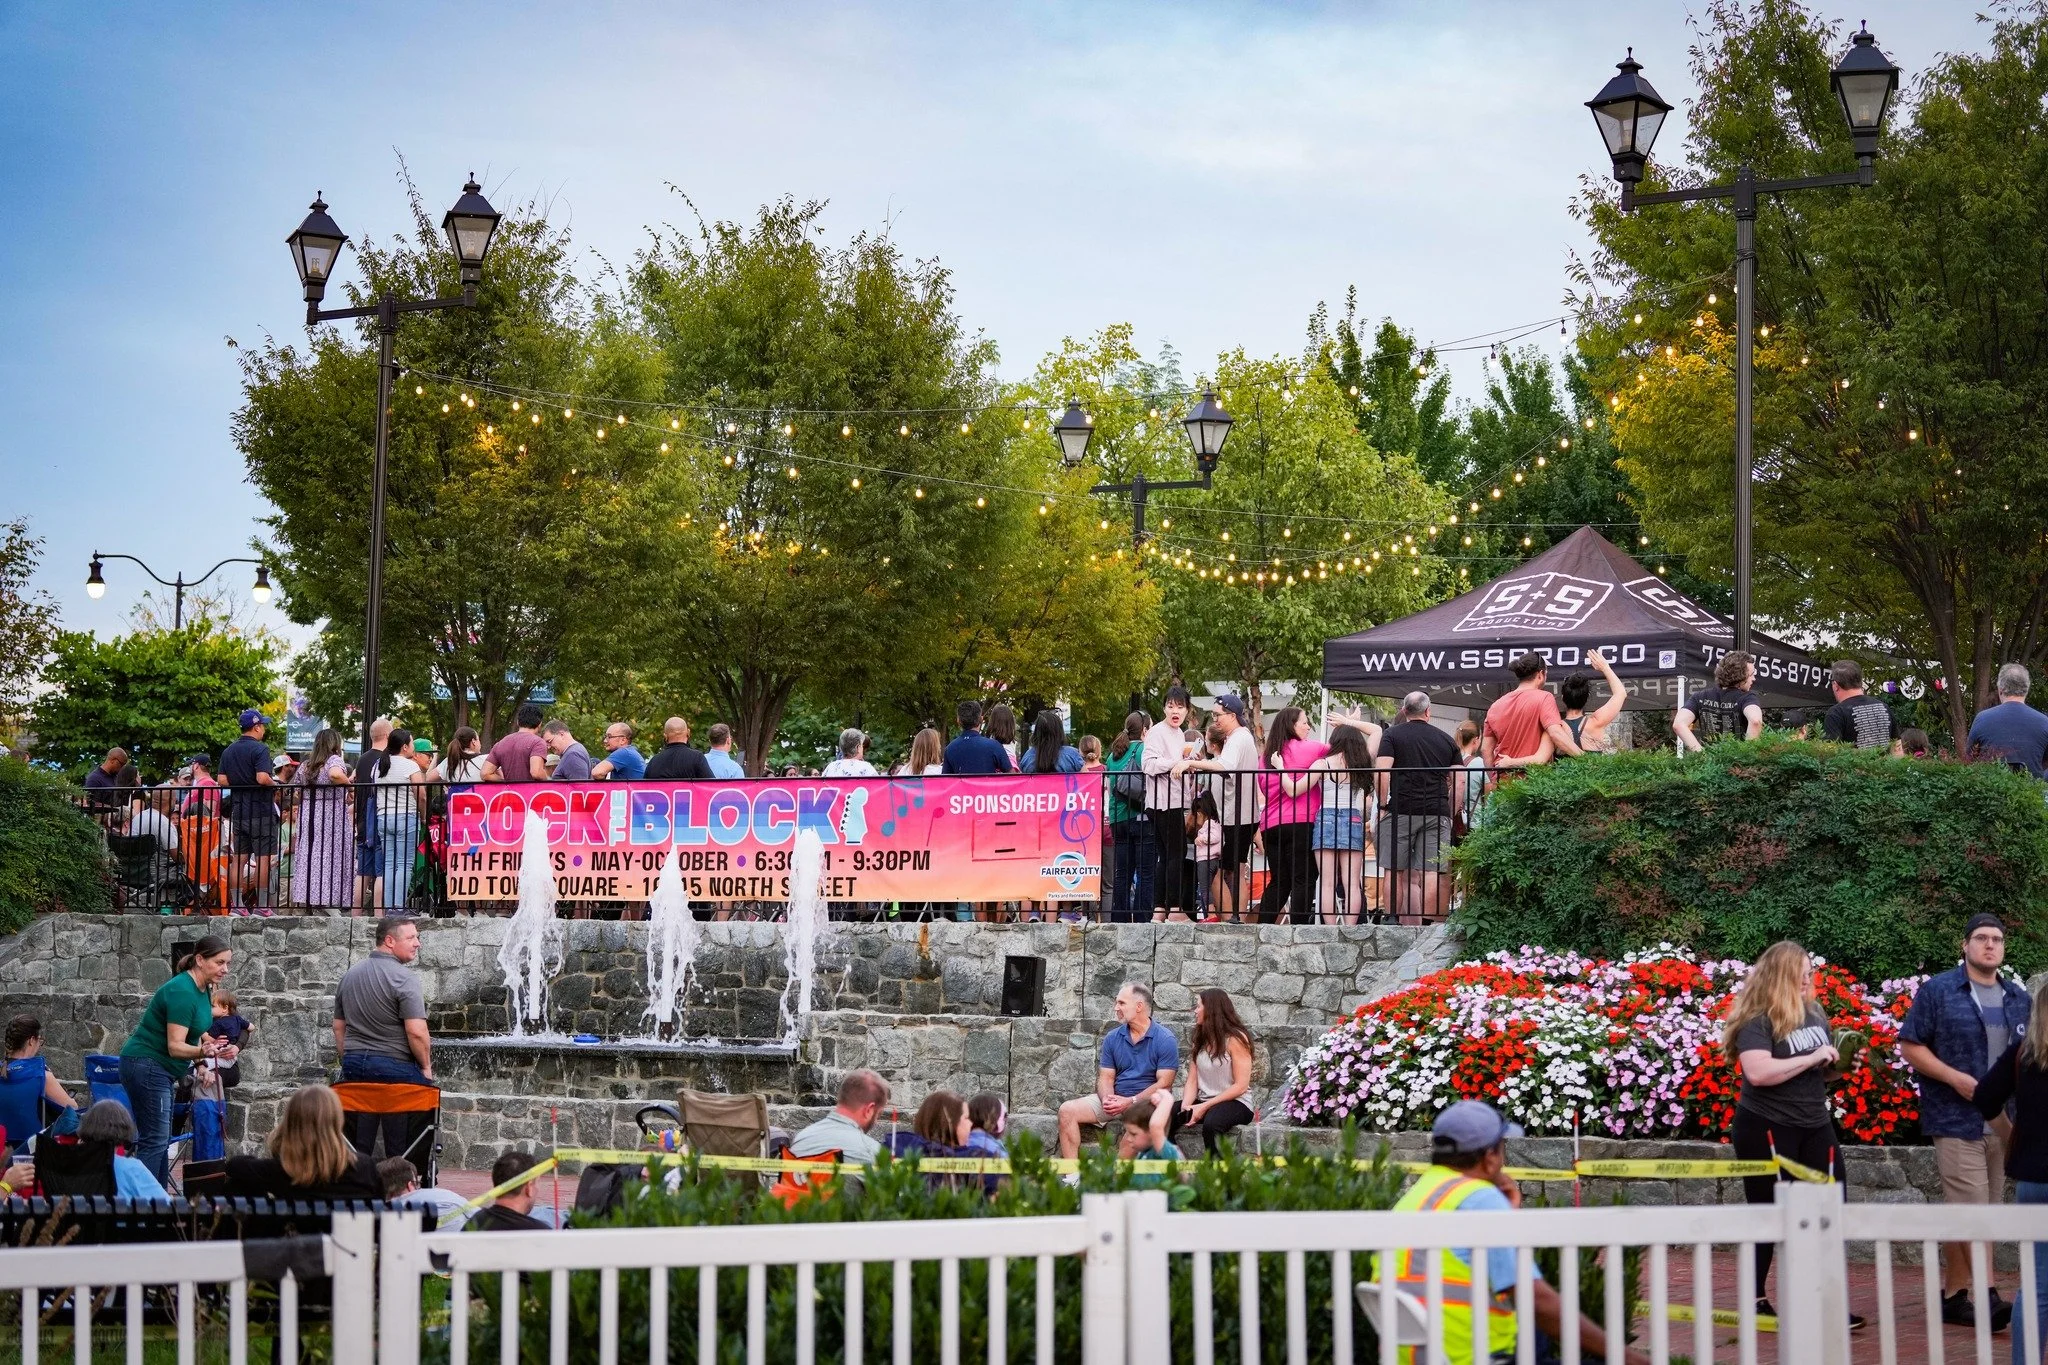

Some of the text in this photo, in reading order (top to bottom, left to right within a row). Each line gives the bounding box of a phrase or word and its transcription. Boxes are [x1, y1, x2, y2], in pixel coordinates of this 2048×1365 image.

[1702, 644, 1833, 689] 7555-8797
[950, 791, 1096, 814] SPONSORED BY:
[449, 787, 841, 847] ROCK THE BLOCK
[451, 851, 482, 871] 4TH
[488, 851, 566, 871] FRIS
[591, 851, 728, 871] MAY-OCOBER
[853, 850, 931, 871] 9:30PM
[1041, 866, 1100, 875] FAIRFAX CITY
[451, 876, 479, 896] OLD
[553, 876, 619, 898] QUARE
[709, 876, 774, 896] NORTH
[781, 876, 858, 897] SEET
